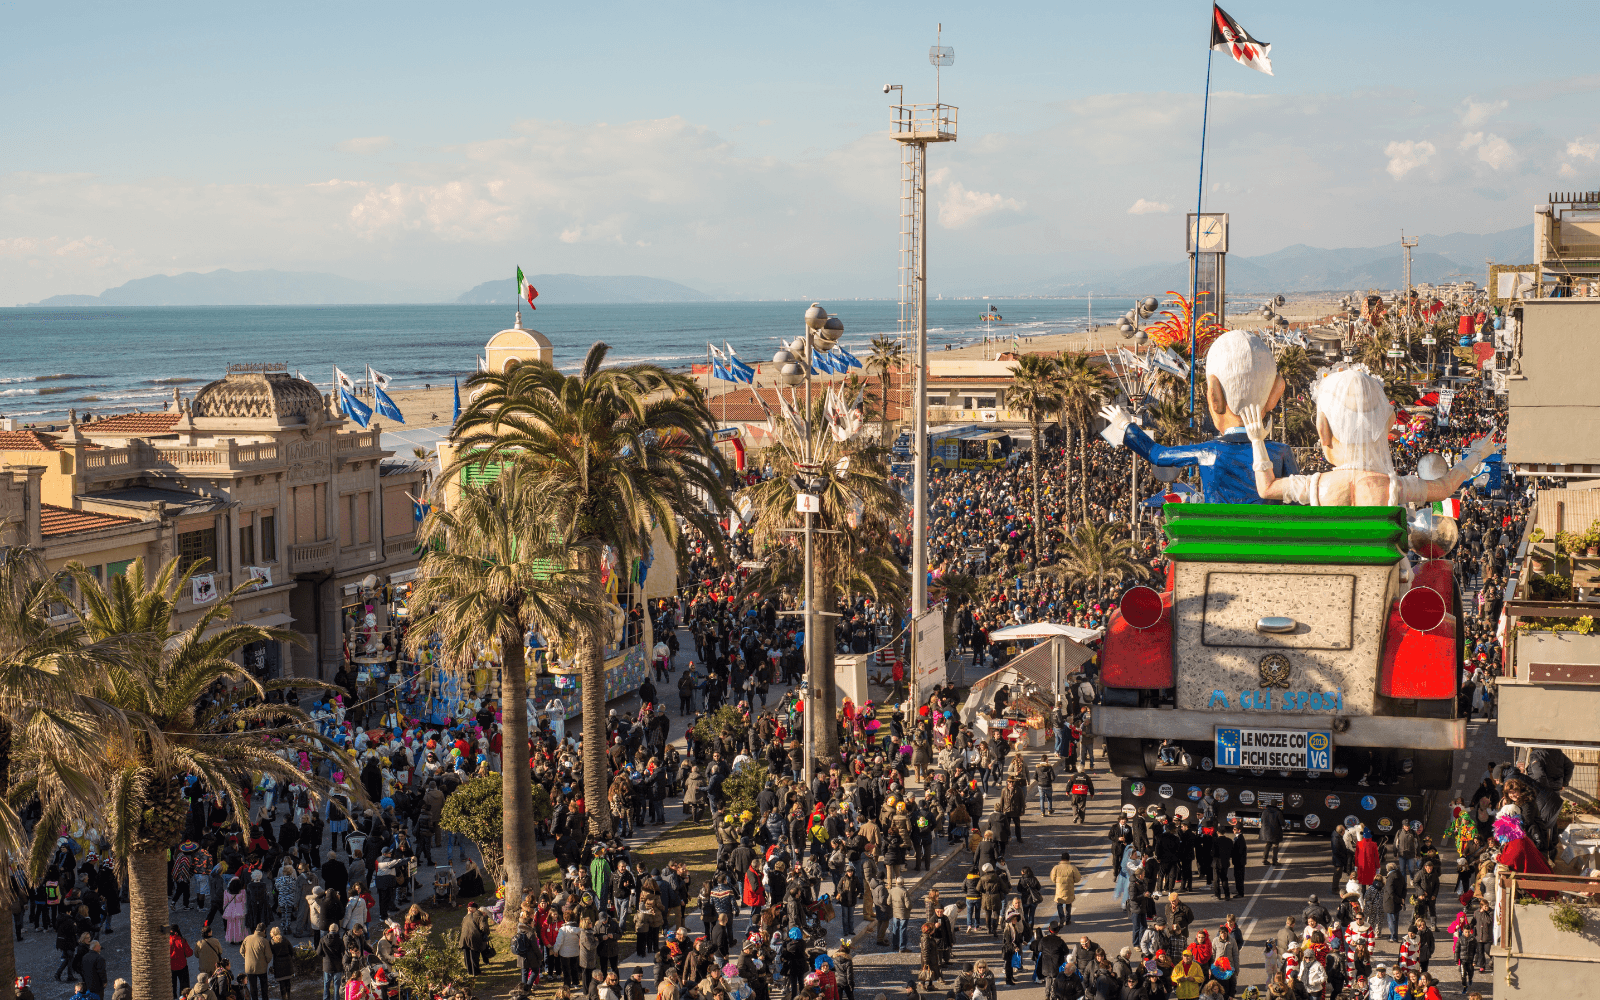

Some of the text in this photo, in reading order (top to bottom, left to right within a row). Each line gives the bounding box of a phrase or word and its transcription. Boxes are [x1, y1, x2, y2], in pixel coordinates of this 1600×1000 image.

[803, 496, 811, 510] 4
[1241, 732, 1306, 748] LE NOZZE COI
[1311, 736, 1327, 746] 2013
[1225, 747, 1237, 765] IT
[1241, 751, 1306, 768] FICHI SECCHI
[1310, 750, 1328, 769] VG
